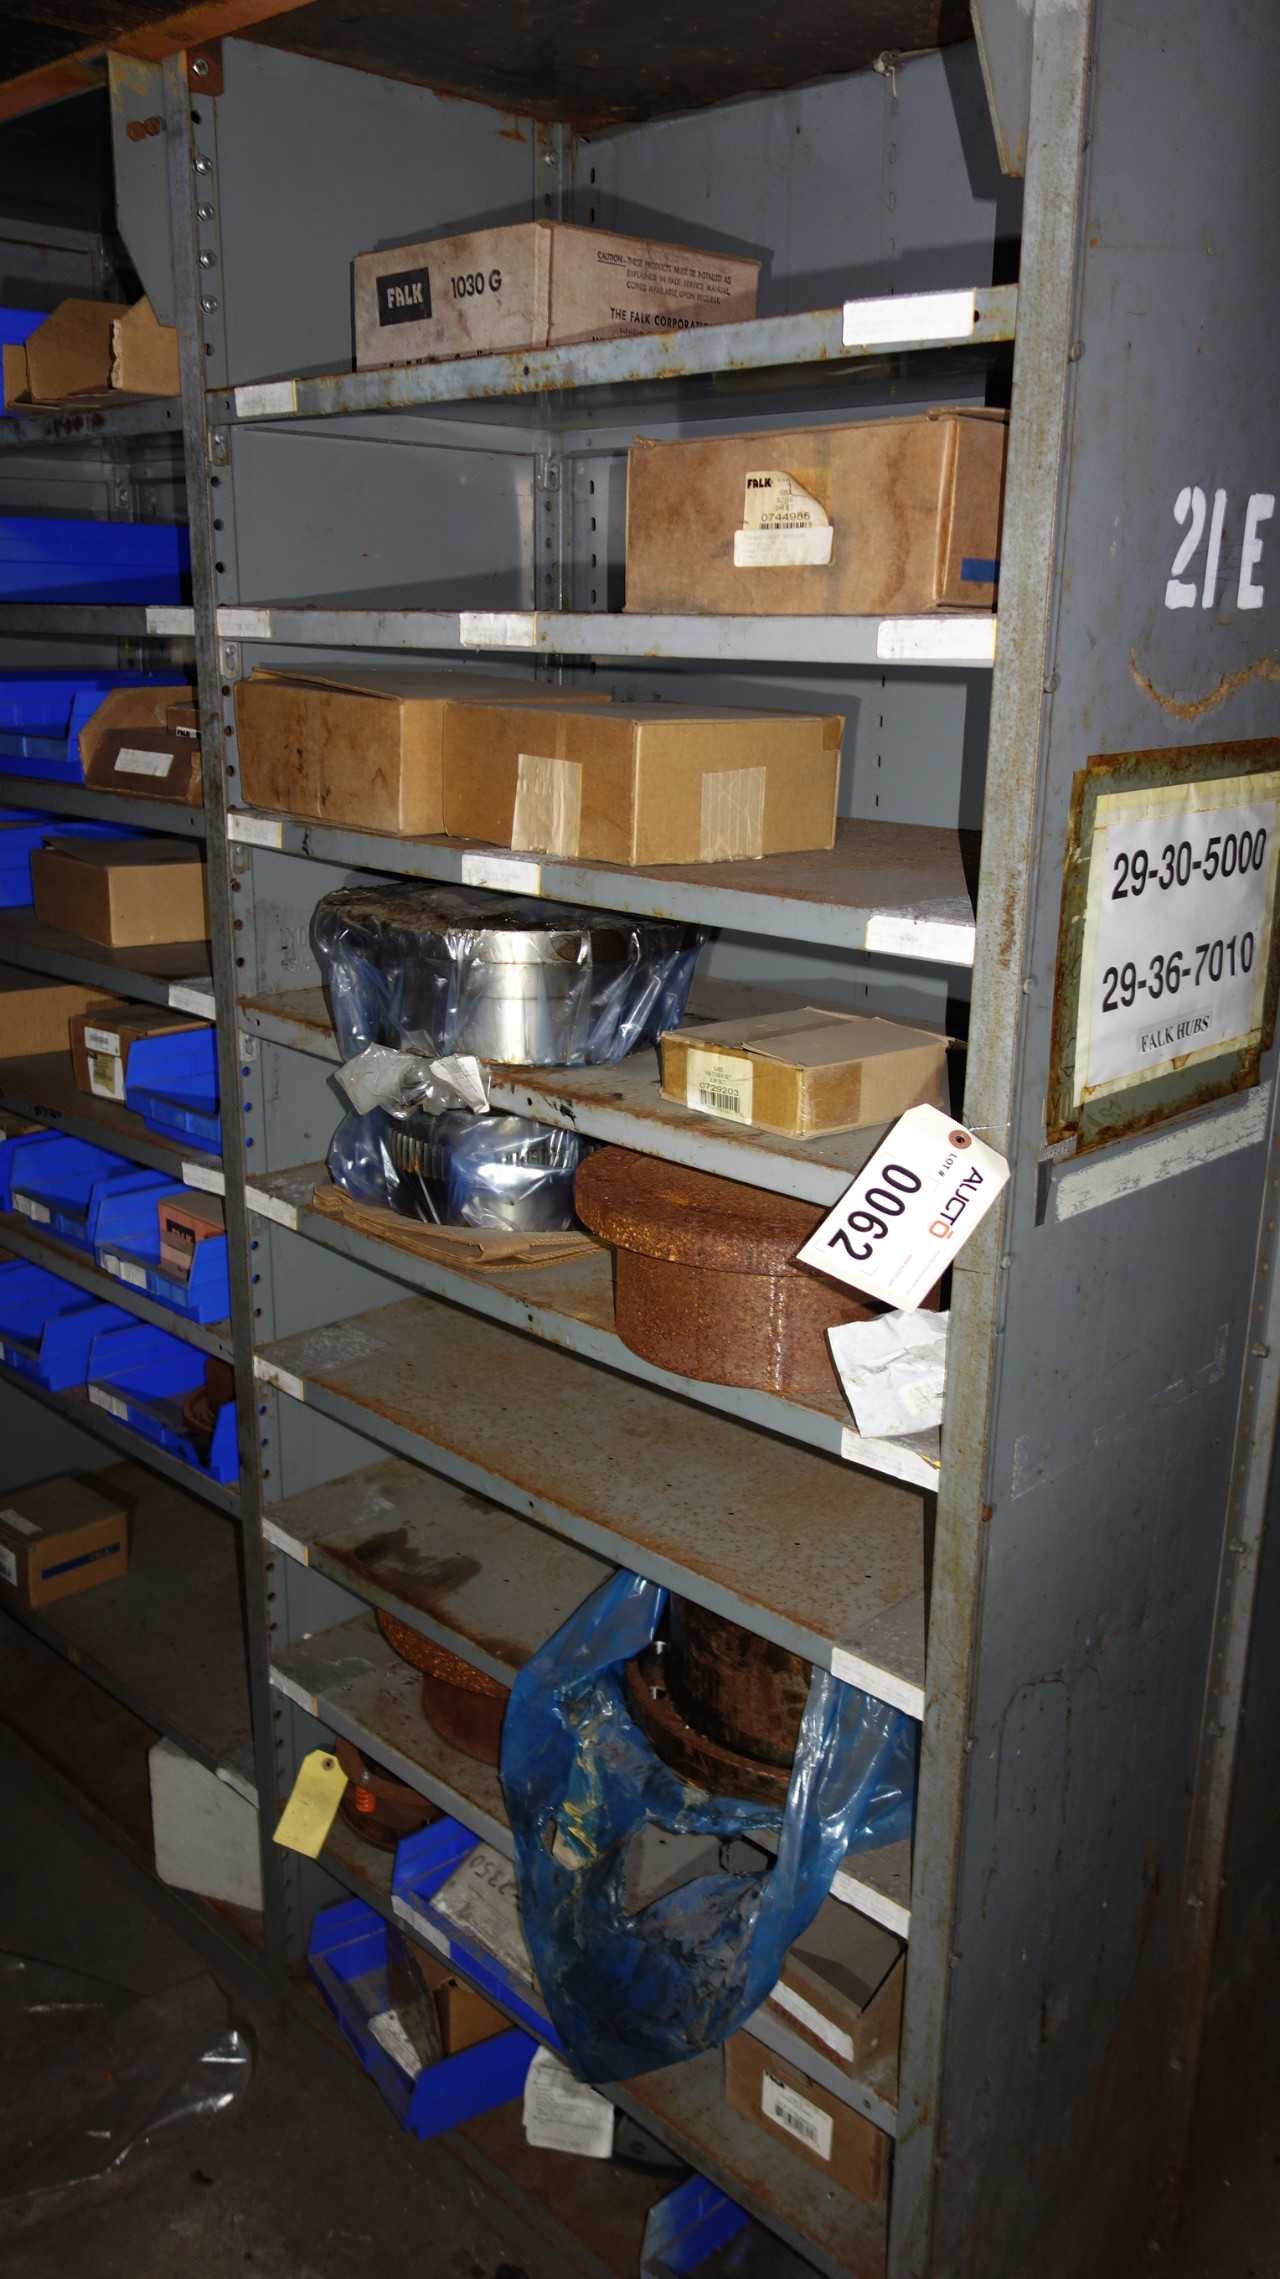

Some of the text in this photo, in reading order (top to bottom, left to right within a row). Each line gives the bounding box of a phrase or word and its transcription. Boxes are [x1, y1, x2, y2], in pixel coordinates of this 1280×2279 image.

[386, 282, 423, 309] FALK
[451, 269, 502, 298] 1030 G
[610, 307, 627, 320] THE
[630, 311, 651, 325] FALK
[747, 477, 772, 489] FALK
[1111, 826, 1267, 901] 29-30-5000
[1101, 931, 1255, 1013] 29-36-7010
[1140, 1013, 1210, 1053] FALK HUBS
[943, 1153, 958, 1171] LOT
[827, 1164, 922, 1261] 0062
